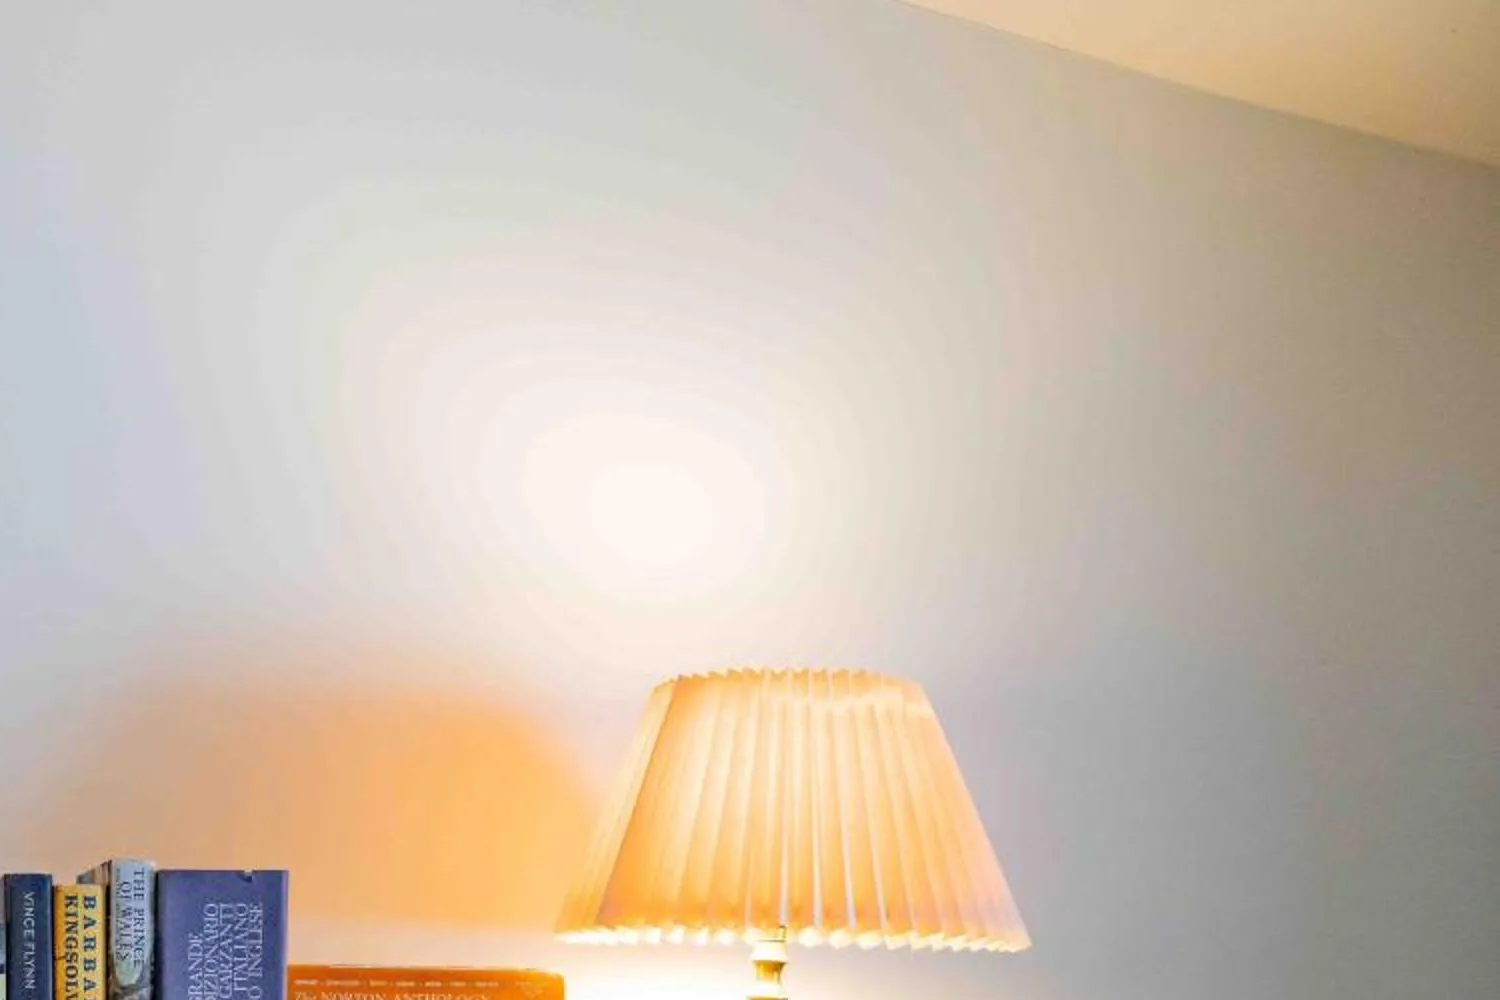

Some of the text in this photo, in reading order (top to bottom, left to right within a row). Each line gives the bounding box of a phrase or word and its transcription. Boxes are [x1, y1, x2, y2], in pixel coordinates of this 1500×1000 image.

[23, 890, 36, 988] VINCE FLYNN
[121, 906, 133, 961] WALES
[133, 867, 146, 967] THE PRINCE
[218, 903, 233, 999] GARZANTI
[233, 903, 248, 992] ITALIANO
[247, 902, 262, 978] INGLESE
